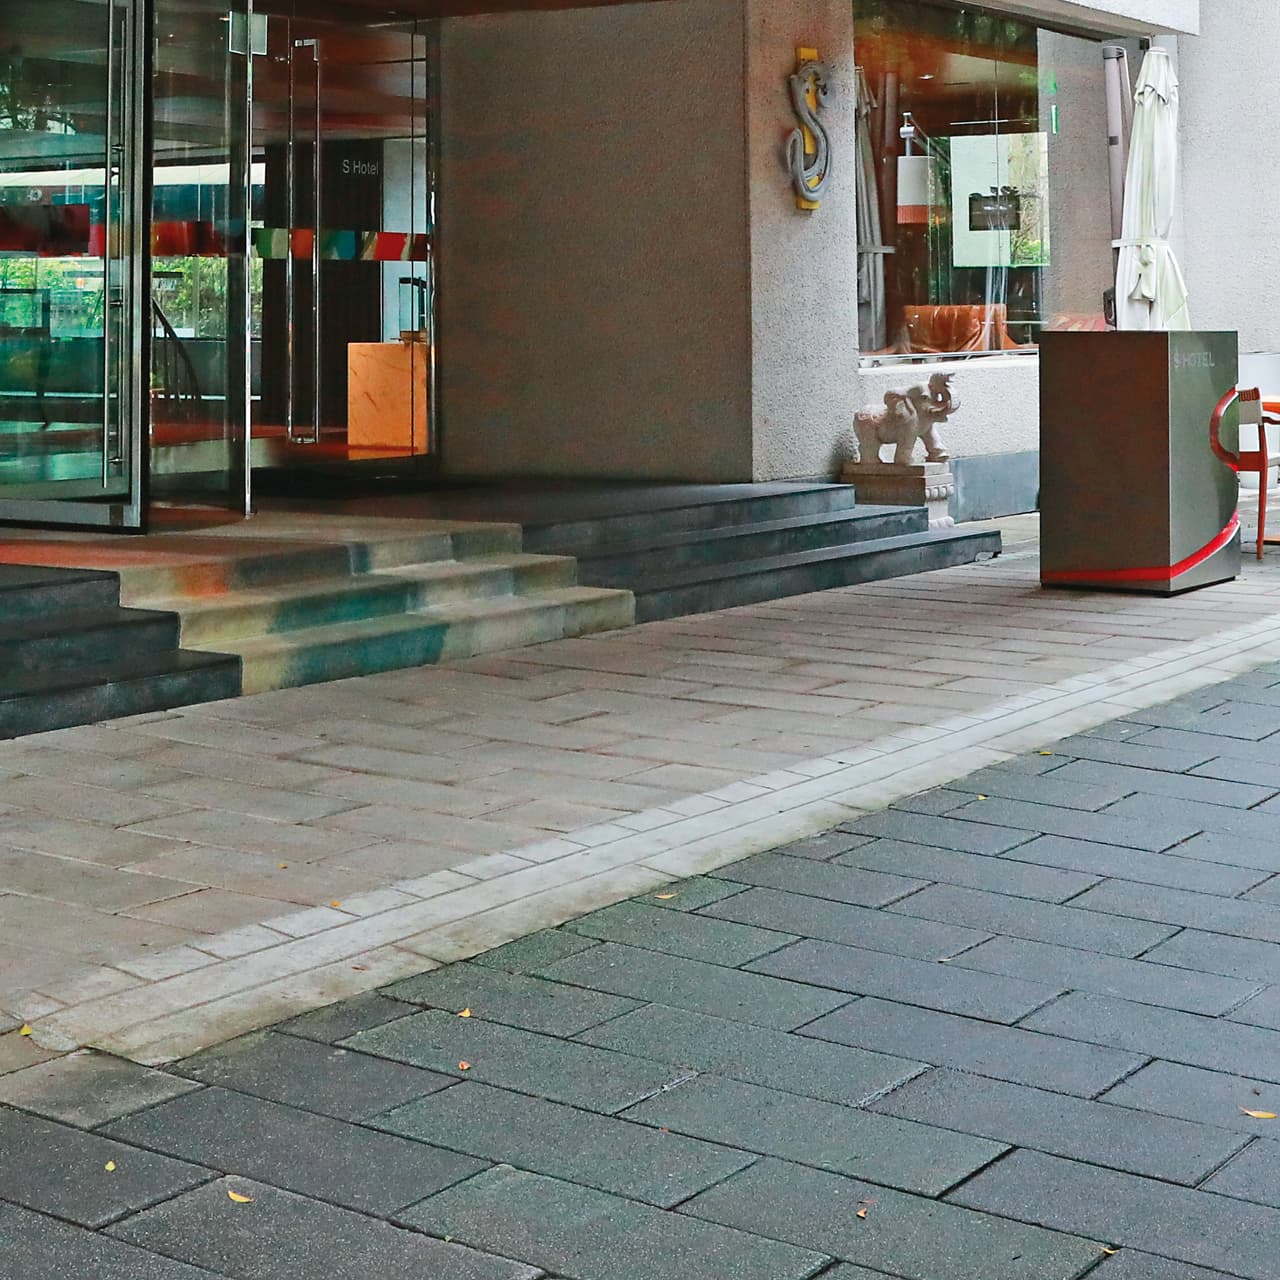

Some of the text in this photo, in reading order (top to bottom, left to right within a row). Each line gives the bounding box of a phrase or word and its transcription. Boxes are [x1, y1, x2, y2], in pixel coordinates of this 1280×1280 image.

[342, 159, 379, 175] S Hotel
[1182, 351, 1216, 369] HOTEL
